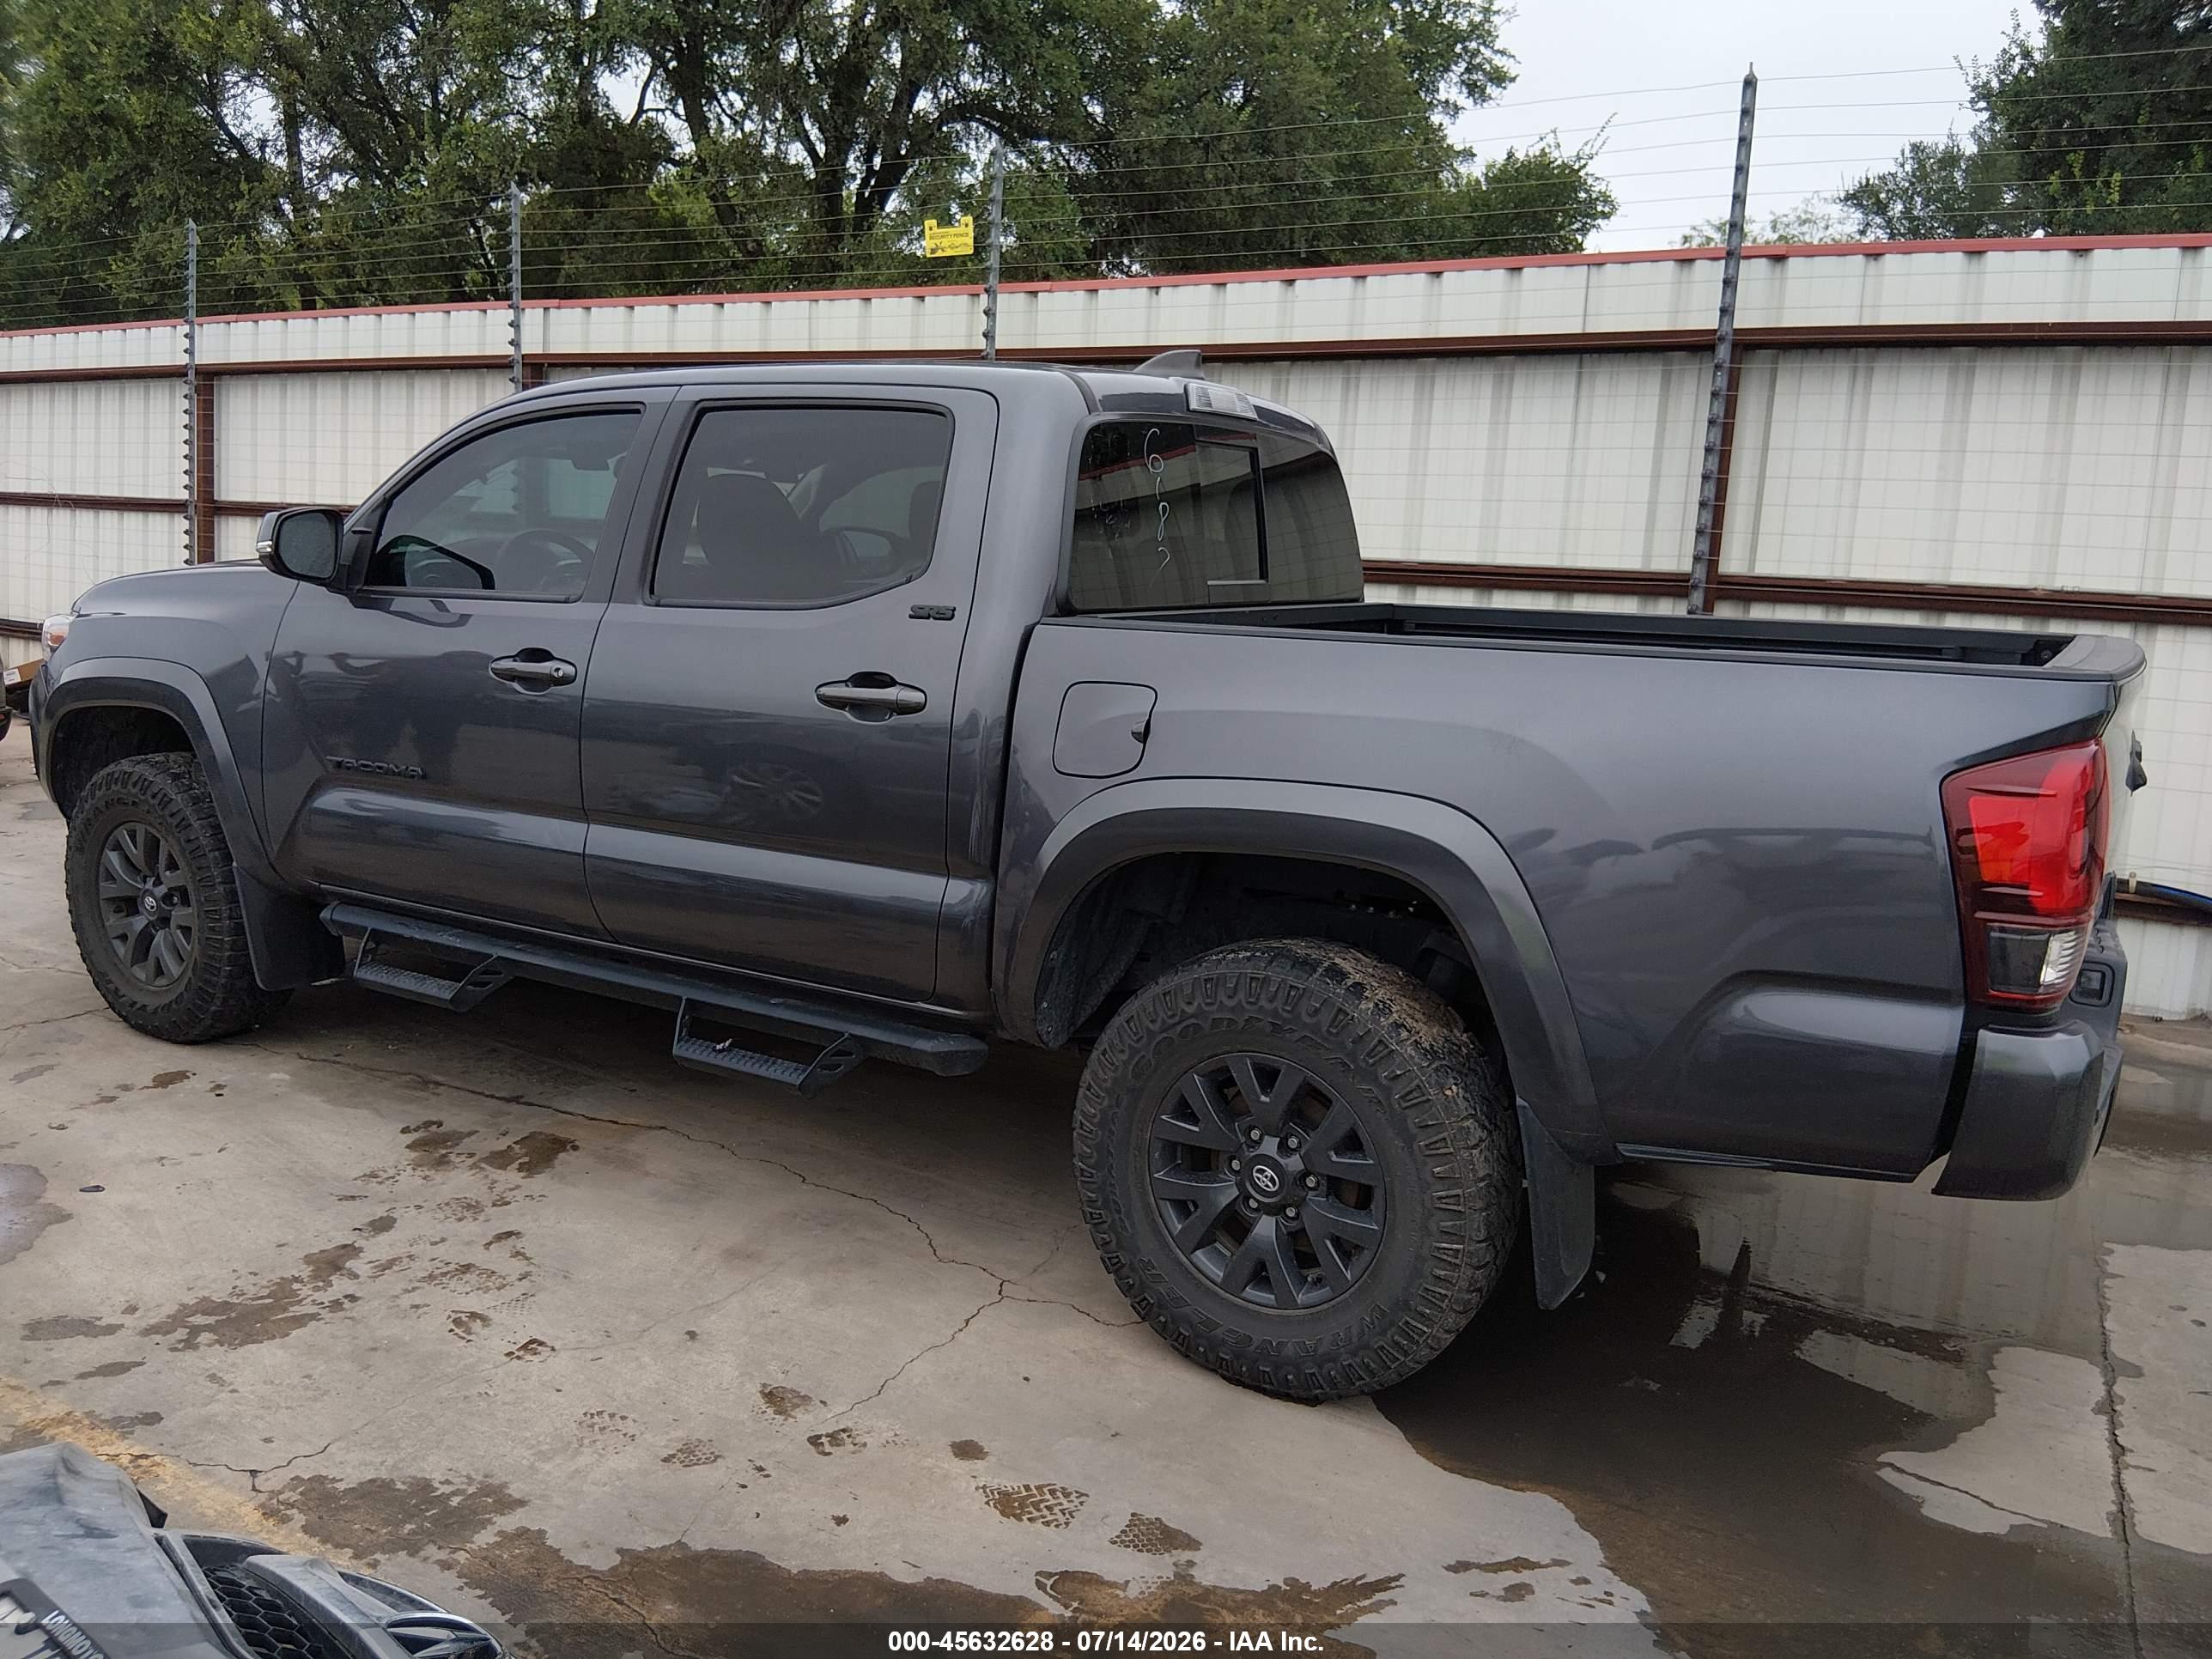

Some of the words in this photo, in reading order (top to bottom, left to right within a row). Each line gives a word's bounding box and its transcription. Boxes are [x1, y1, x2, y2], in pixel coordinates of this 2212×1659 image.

[908, 605, 957, 621] SR5
[325, 755, 427, 781] TACOMA
[1137, 1256, 1390, 1357] WRANGLER
